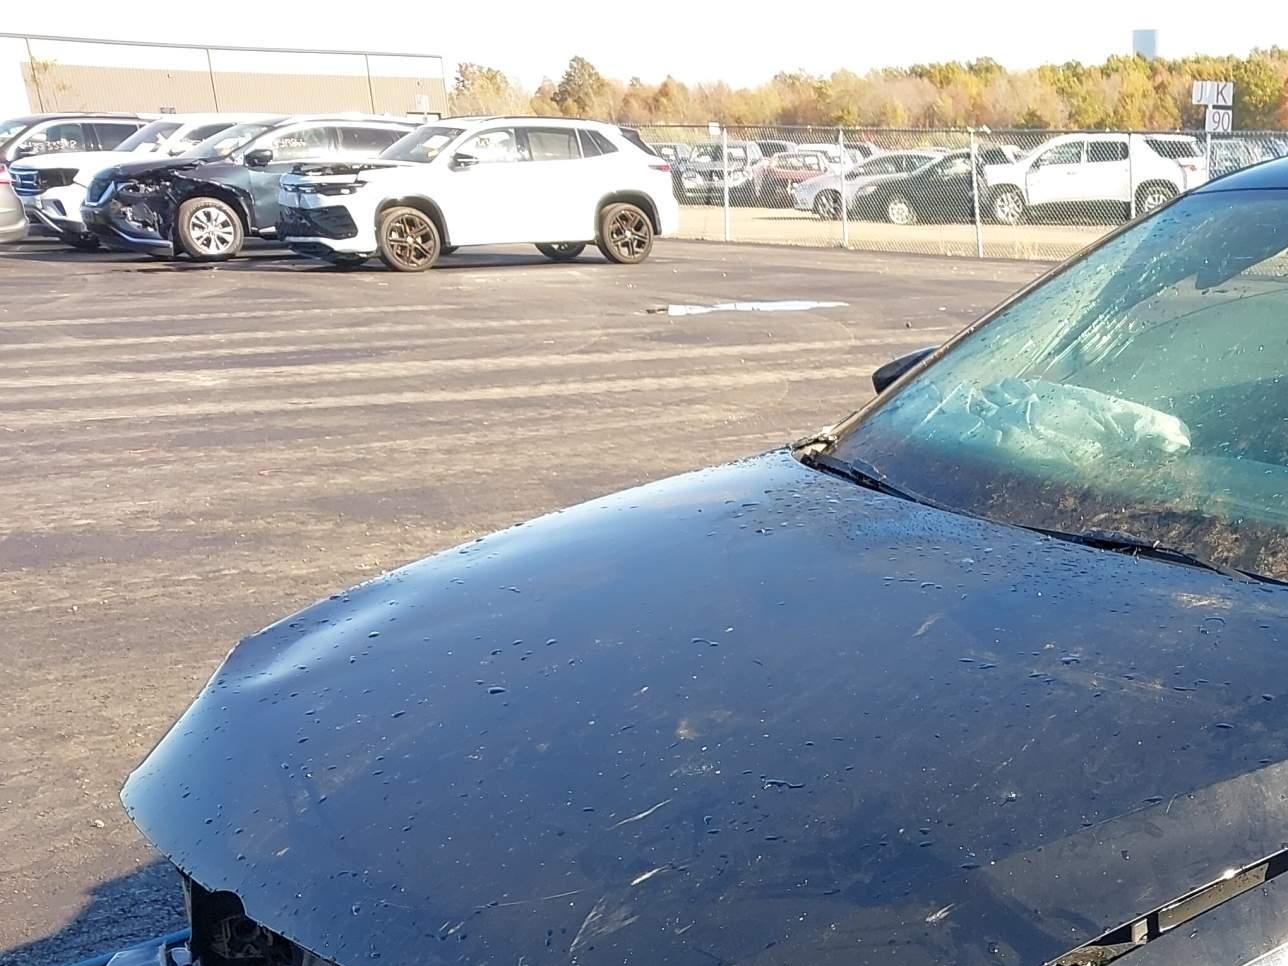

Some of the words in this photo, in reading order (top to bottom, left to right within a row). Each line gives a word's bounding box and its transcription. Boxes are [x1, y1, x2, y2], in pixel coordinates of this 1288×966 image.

[1196, 82, 1204, 103] J
[1215, 82, 1228, 105] K
[1212, 110, 1231, 131] 90
